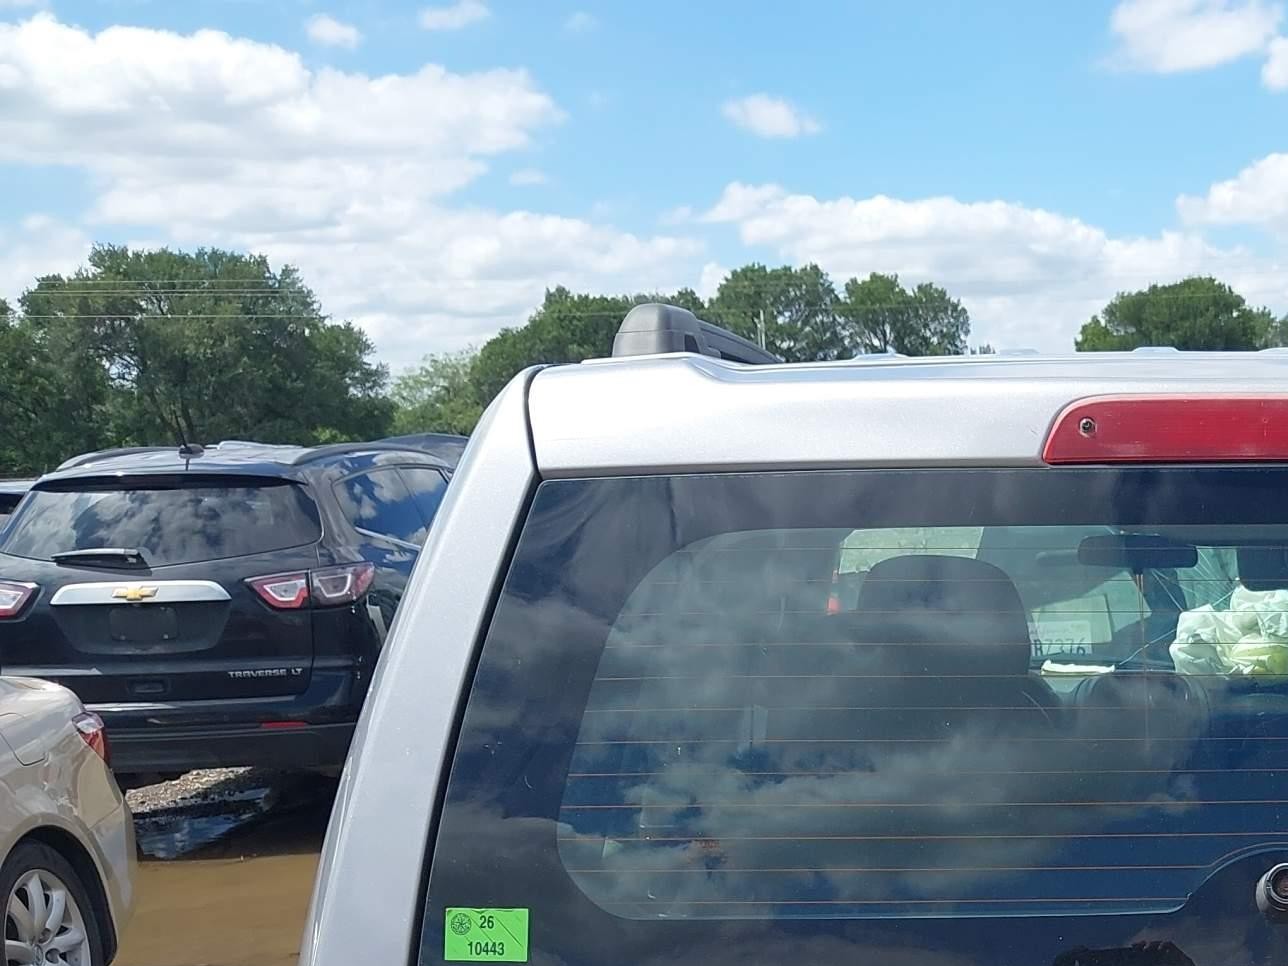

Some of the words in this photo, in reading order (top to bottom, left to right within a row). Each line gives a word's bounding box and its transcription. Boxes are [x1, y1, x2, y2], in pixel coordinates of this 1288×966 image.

[228, 668, 287, 678] TRAVERSE
[291, 667, 303, 676] LT
[479, 915, 495, 929] 26
[467, 941, 505, 956] 10443
